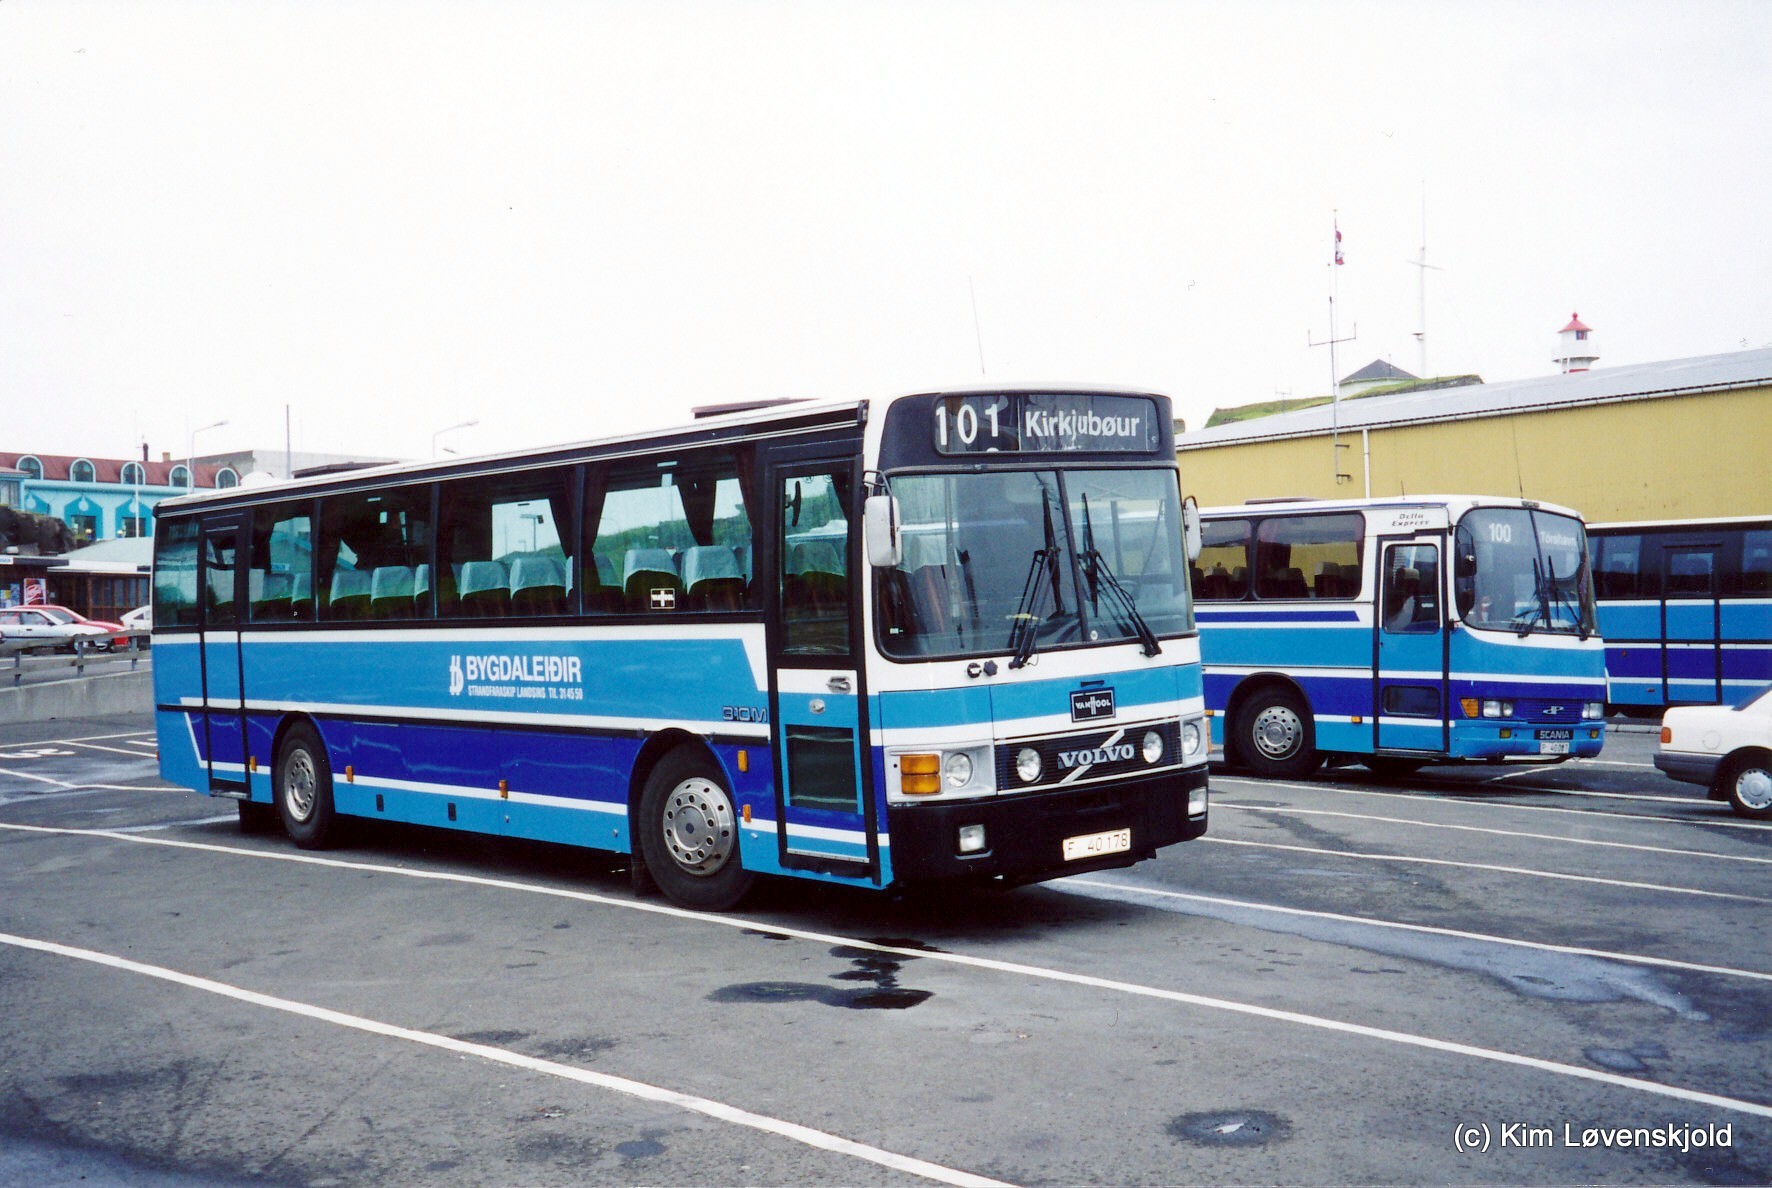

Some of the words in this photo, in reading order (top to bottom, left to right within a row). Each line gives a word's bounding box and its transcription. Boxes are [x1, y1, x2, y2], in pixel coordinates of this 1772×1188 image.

[935, 404, 1000, 446] 101
[1025, 409, 1140, 441] Kirkjubøur
[1488, 522, 1512, 543] 100
[465, 655, 582, 683] BYGDALEIÐIR
[1539, 730, 1570, 740] SCANIA
[1058, 744, 1135, 768] VOLVO
[1067, 841, 1075, 856] F
[1087, 832, 1129, 854] 40178
